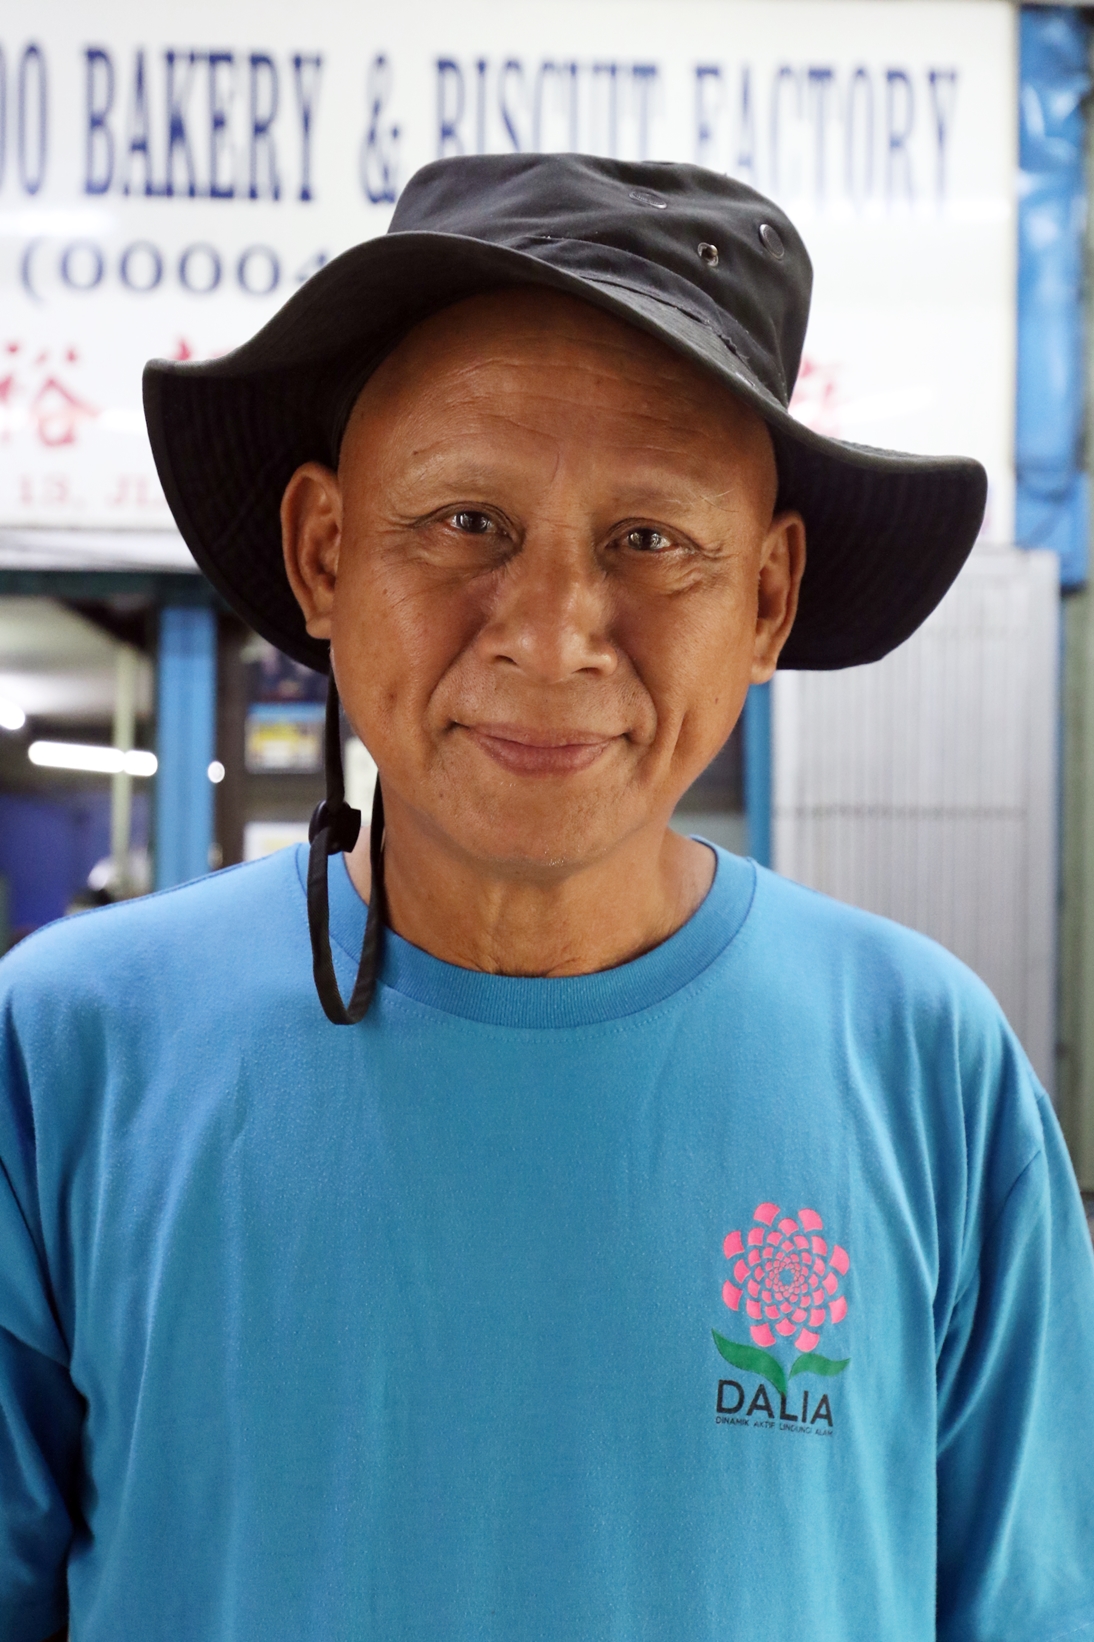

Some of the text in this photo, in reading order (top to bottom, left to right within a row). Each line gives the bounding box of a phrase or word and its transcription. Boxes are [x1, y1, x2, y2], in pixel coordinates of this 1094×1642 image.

[0, 40, 50, 197] O
[82, 45, 324, 203] BAKERY
[360, 53, 398, 204] &
[693, 66, 958, 208] FACTORY
[716, 1379, 833, 1427] DALIA
[716, 1416, 749, 1427] DINAMIK
